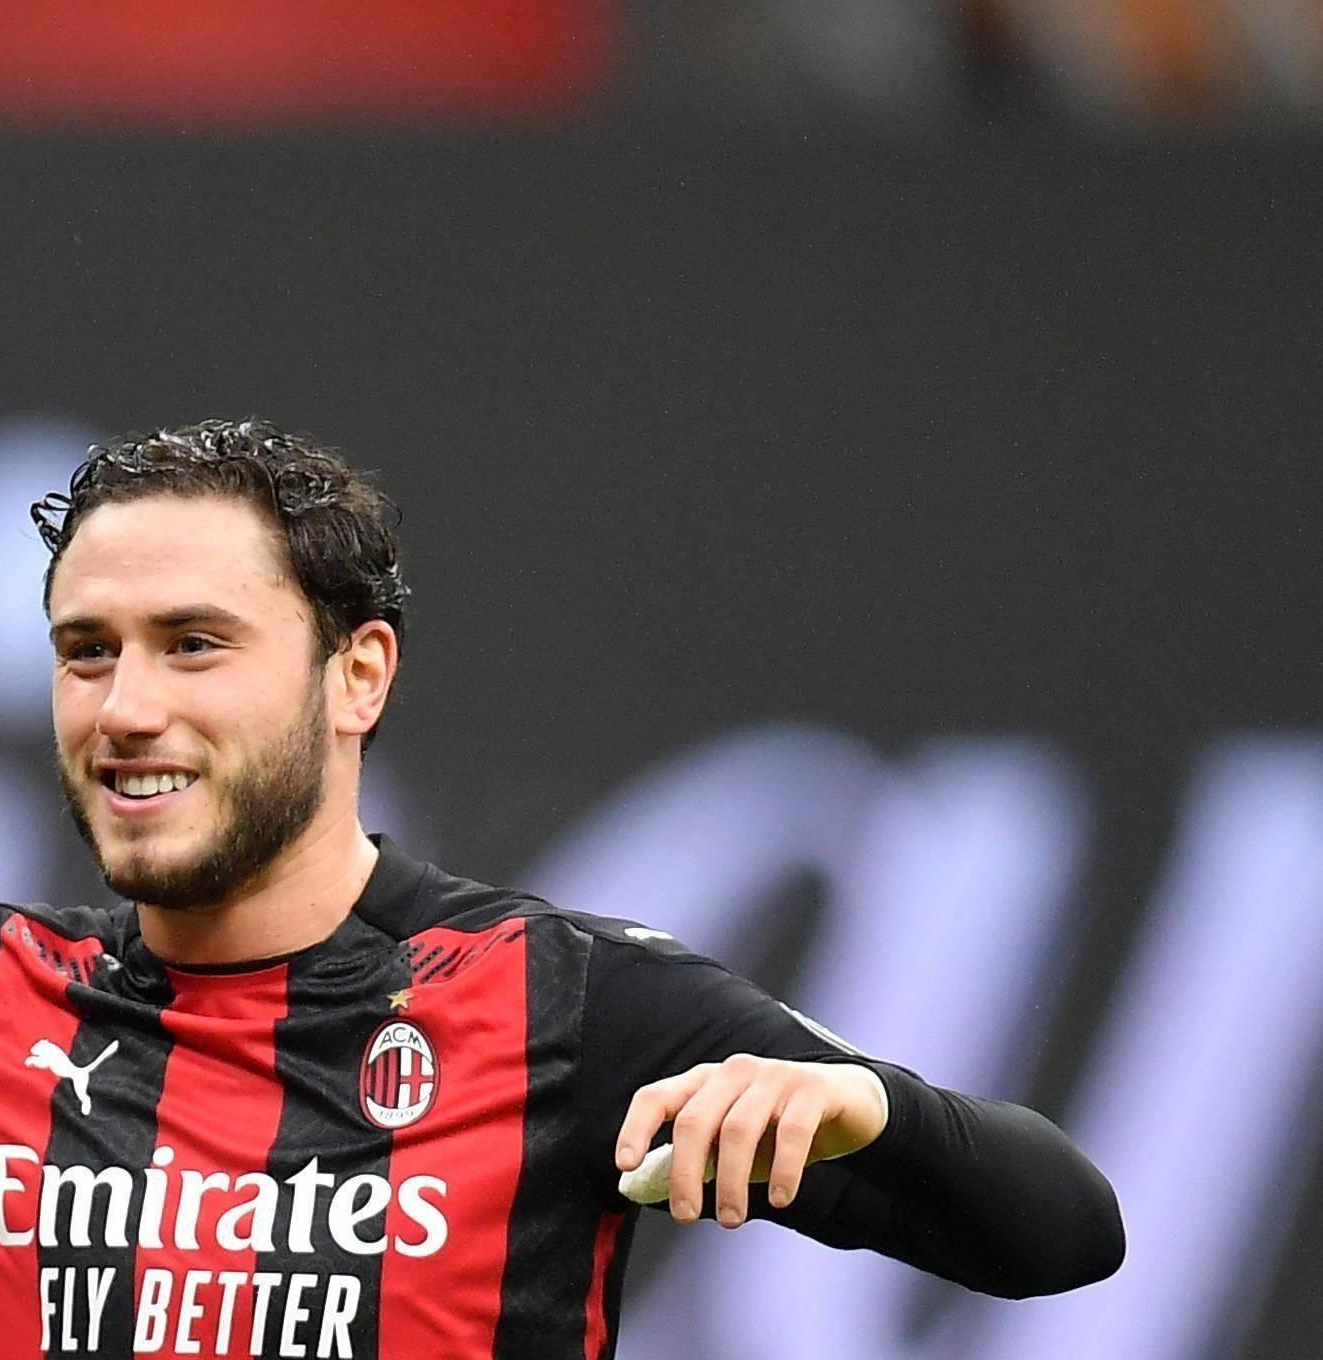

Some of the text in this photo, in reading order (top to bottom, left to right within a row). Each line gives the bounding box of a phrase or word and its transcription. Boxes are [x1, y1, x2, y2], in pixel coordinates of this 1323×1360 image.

[379, 1026, 423, 1051] ACM
[39, 1266, 362, 1360] FLY BETTER
